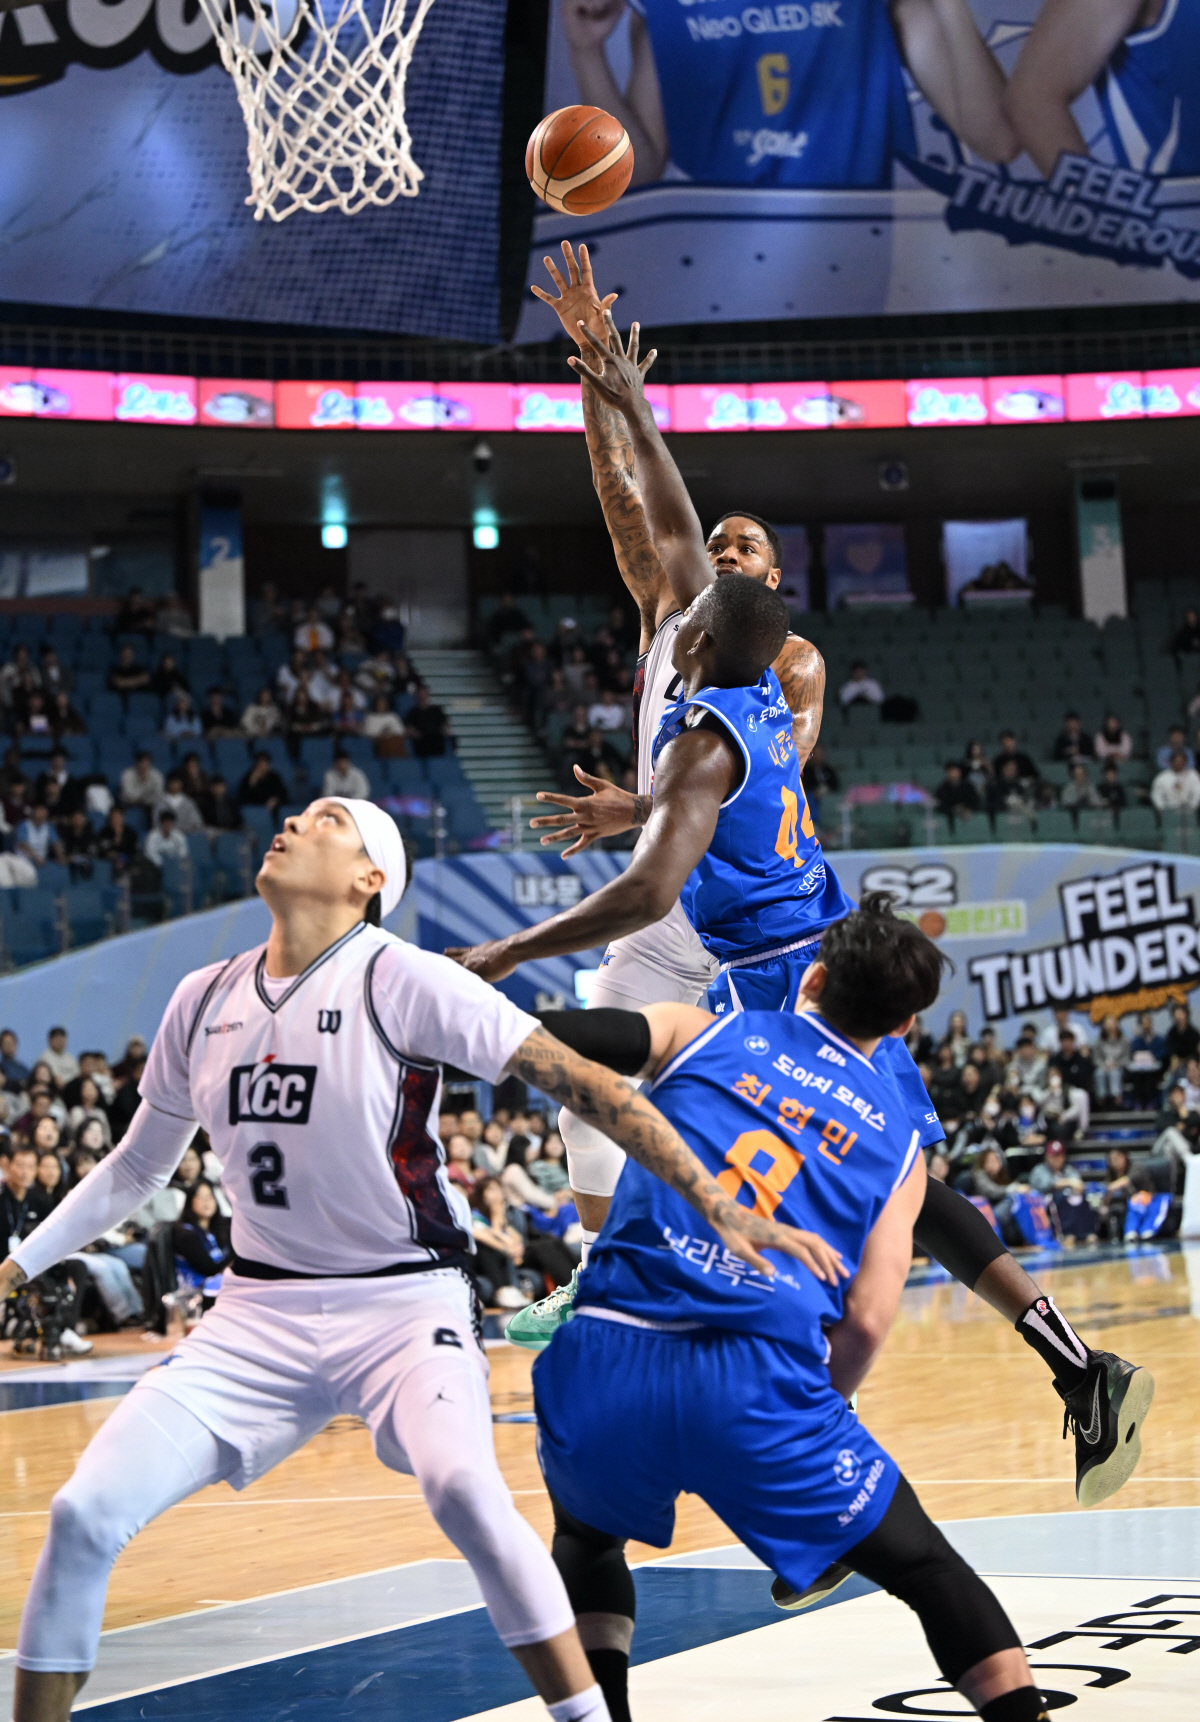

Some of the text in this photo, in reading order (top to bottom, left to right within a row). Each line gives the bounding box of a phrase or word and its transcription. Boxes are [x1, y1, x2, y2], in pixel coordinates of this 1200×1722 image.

[686, 14, 742, 42] Neo
[741, 4, 810, 34] QLED
[756, 53, 790, 116] 6
[951, 166, 1200, 266] THUNDEROU
[1051, 153, 1154, 217] FEEL
[864, 867, 955, 904] S2
[1061, 865, 1189, 941] FEEL
[971, 923, 1200, 1016] THUNDER
[237, 1055, 308, 1120] KCC
[771, 1053, 887, 1132] 도이치 모터스
[247, 1141, 291, 1211] 2
[716, 1129, 806, 1222] 8
